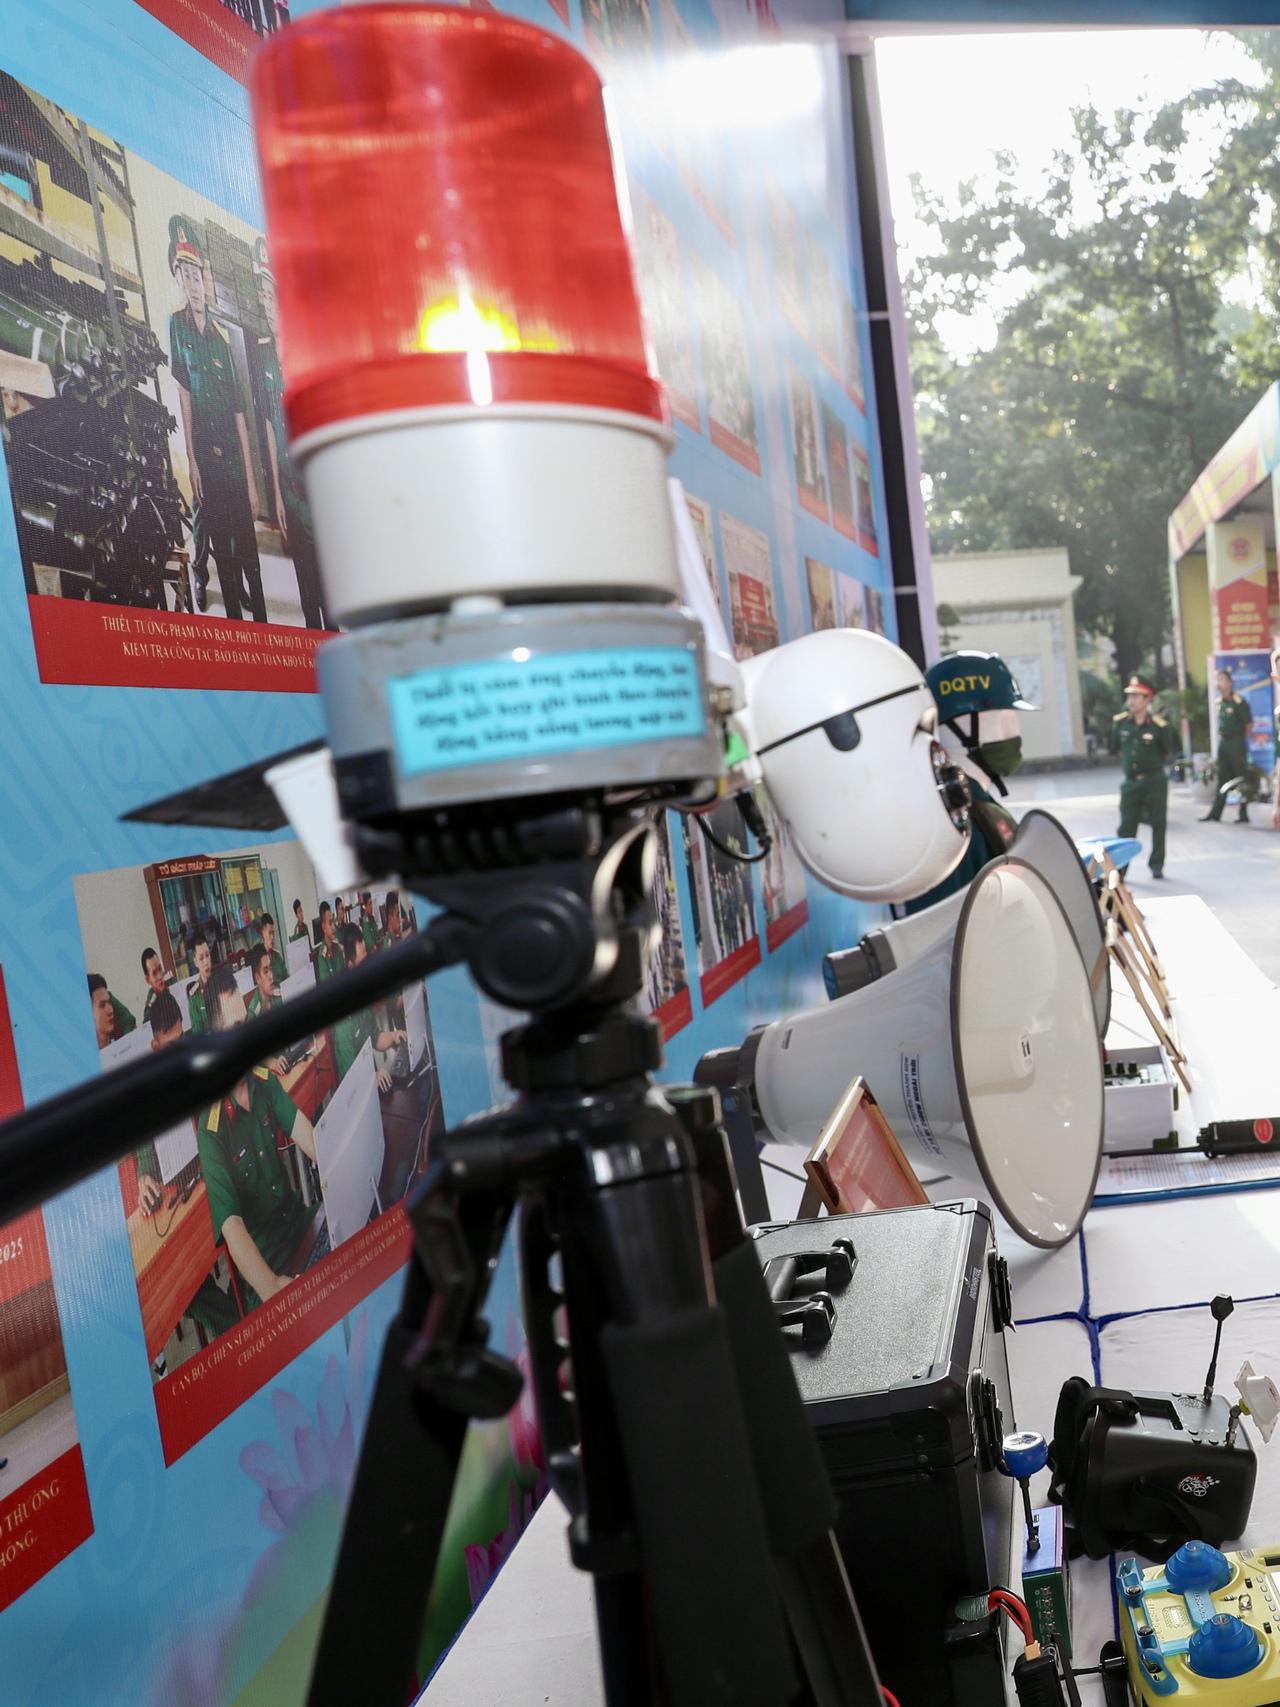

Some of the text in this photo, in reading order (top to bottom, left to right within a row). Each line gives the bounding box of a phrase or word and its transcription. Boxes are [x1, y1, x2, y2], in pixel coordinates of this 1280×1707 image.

[170, 623, 195, 641] PHẠM
[150, 644, 170, 659] TRA
[170, 642, 194, 661] CÔNG
[939, 675, 991, 696] DQTV
